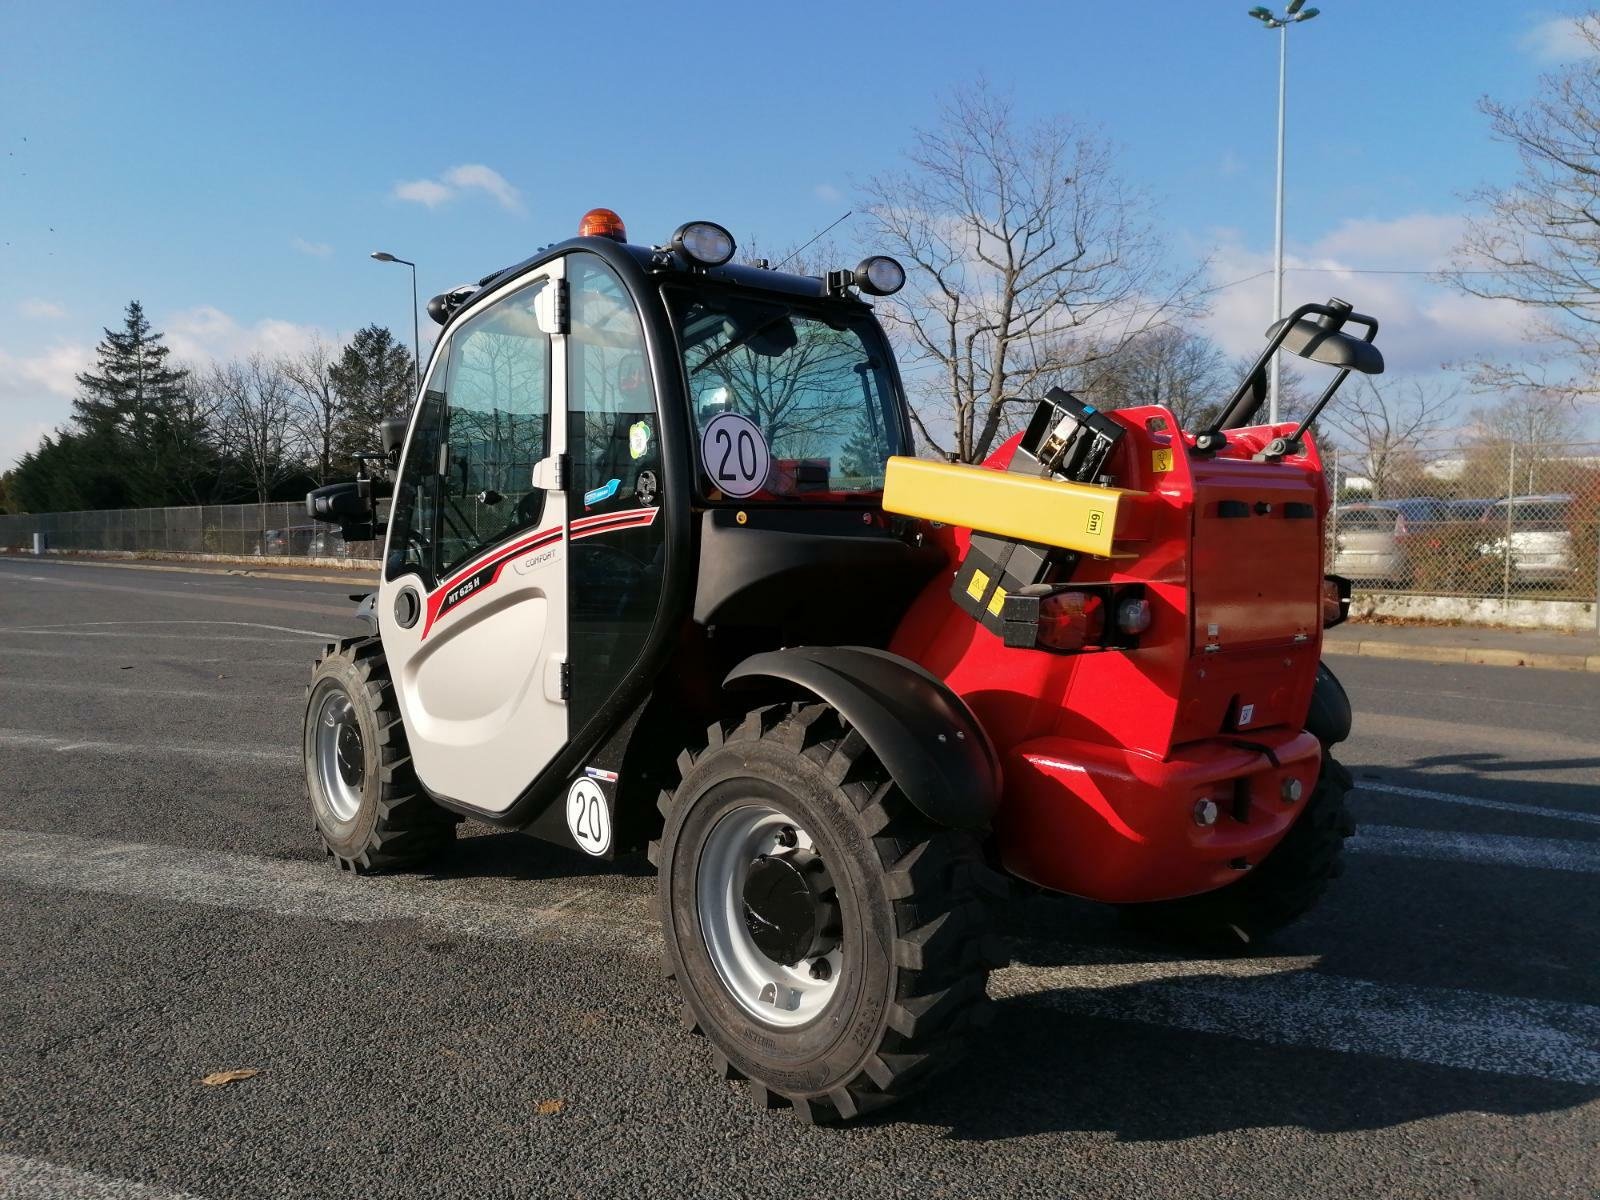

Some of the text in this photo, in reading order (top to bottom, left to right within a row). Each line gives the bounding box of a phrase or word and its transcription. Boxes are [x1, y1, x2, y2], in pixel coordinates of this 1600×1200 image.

[715, 428, 757, 481] 20
[525, 549, 556, 568] COMFORT
[448, 576, 480, 605] MT 625 H
[576, 791, 602, 842] 20
